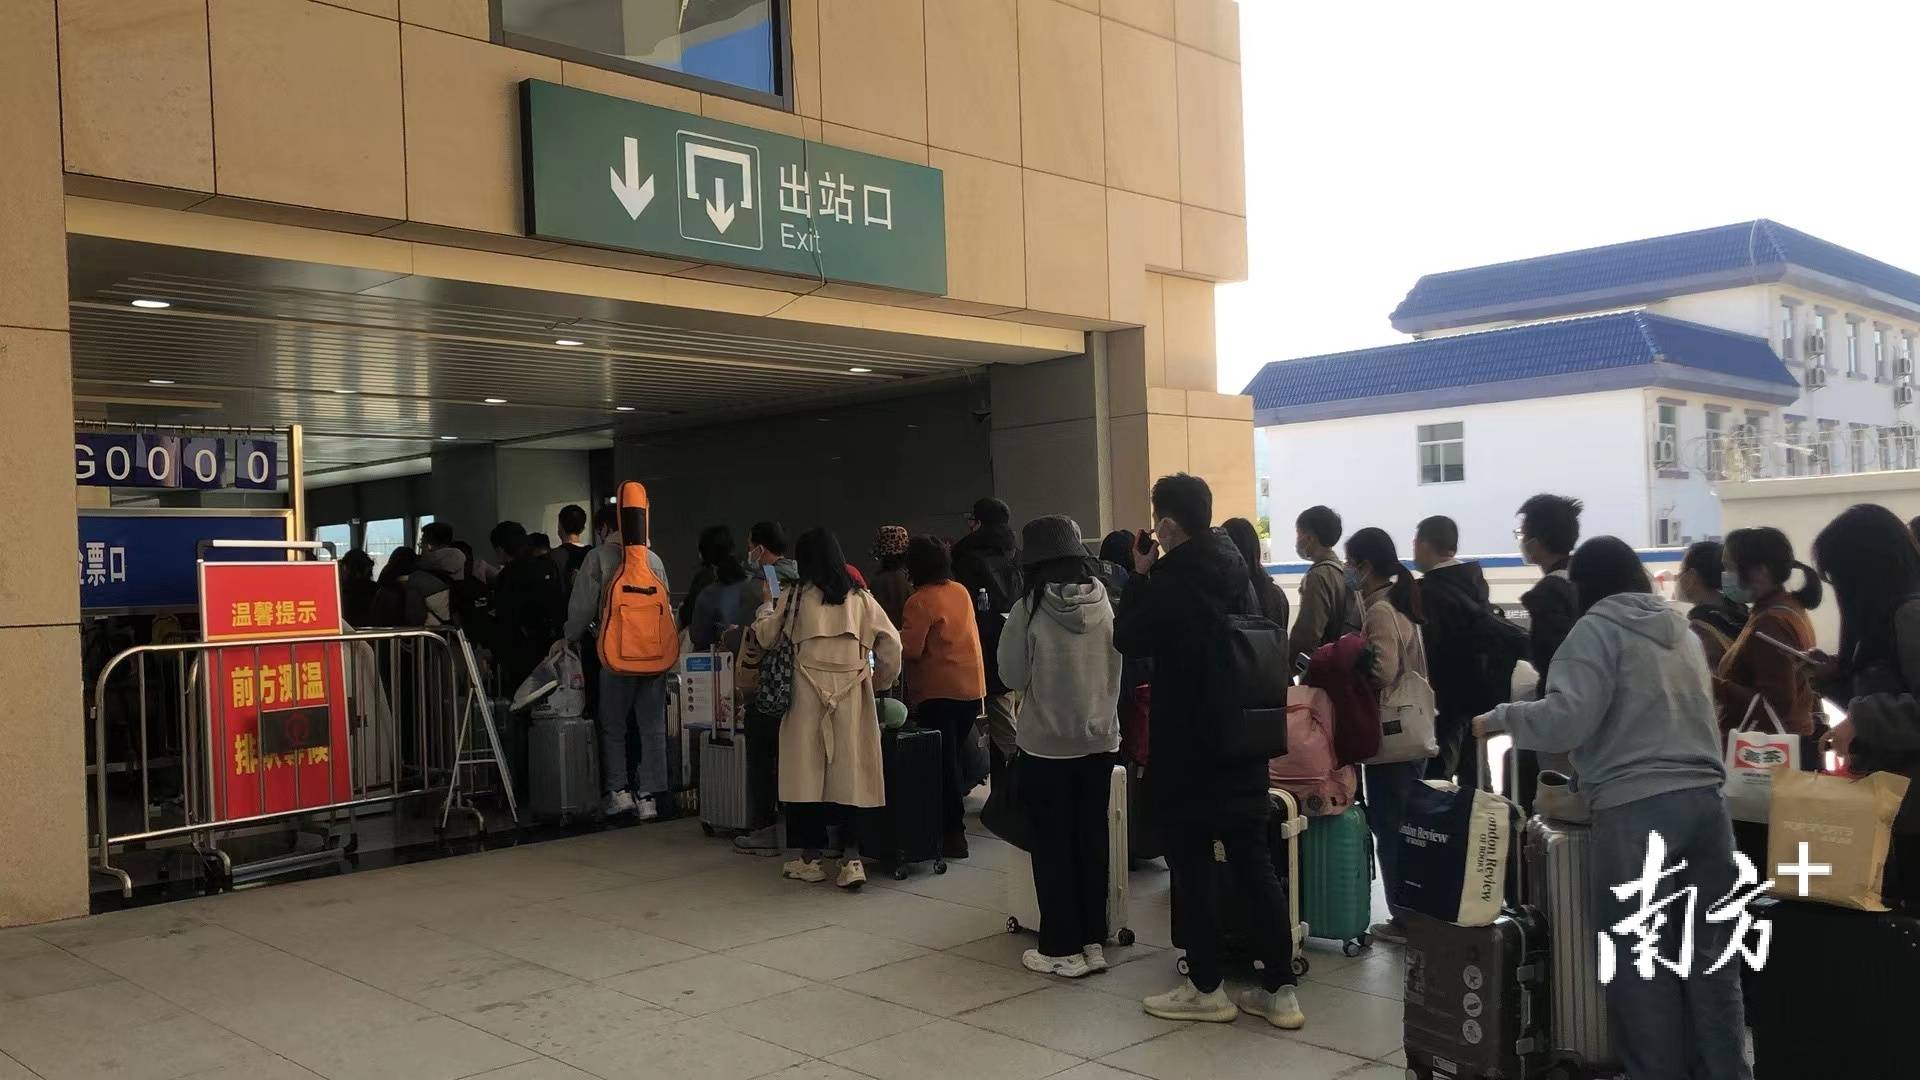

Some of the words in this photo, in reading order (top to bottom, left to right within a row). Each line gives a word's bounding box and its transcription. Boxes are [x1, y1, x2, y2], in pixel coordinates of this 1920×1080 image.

[780, 163, 892, 230] 出站口
[780, 222, 822, 254] Exit
[231, 600, 317, 627] 温馨提示
[231, 662, 325, 709] 前方测温
[1480, 859, 1497, 902] Review
